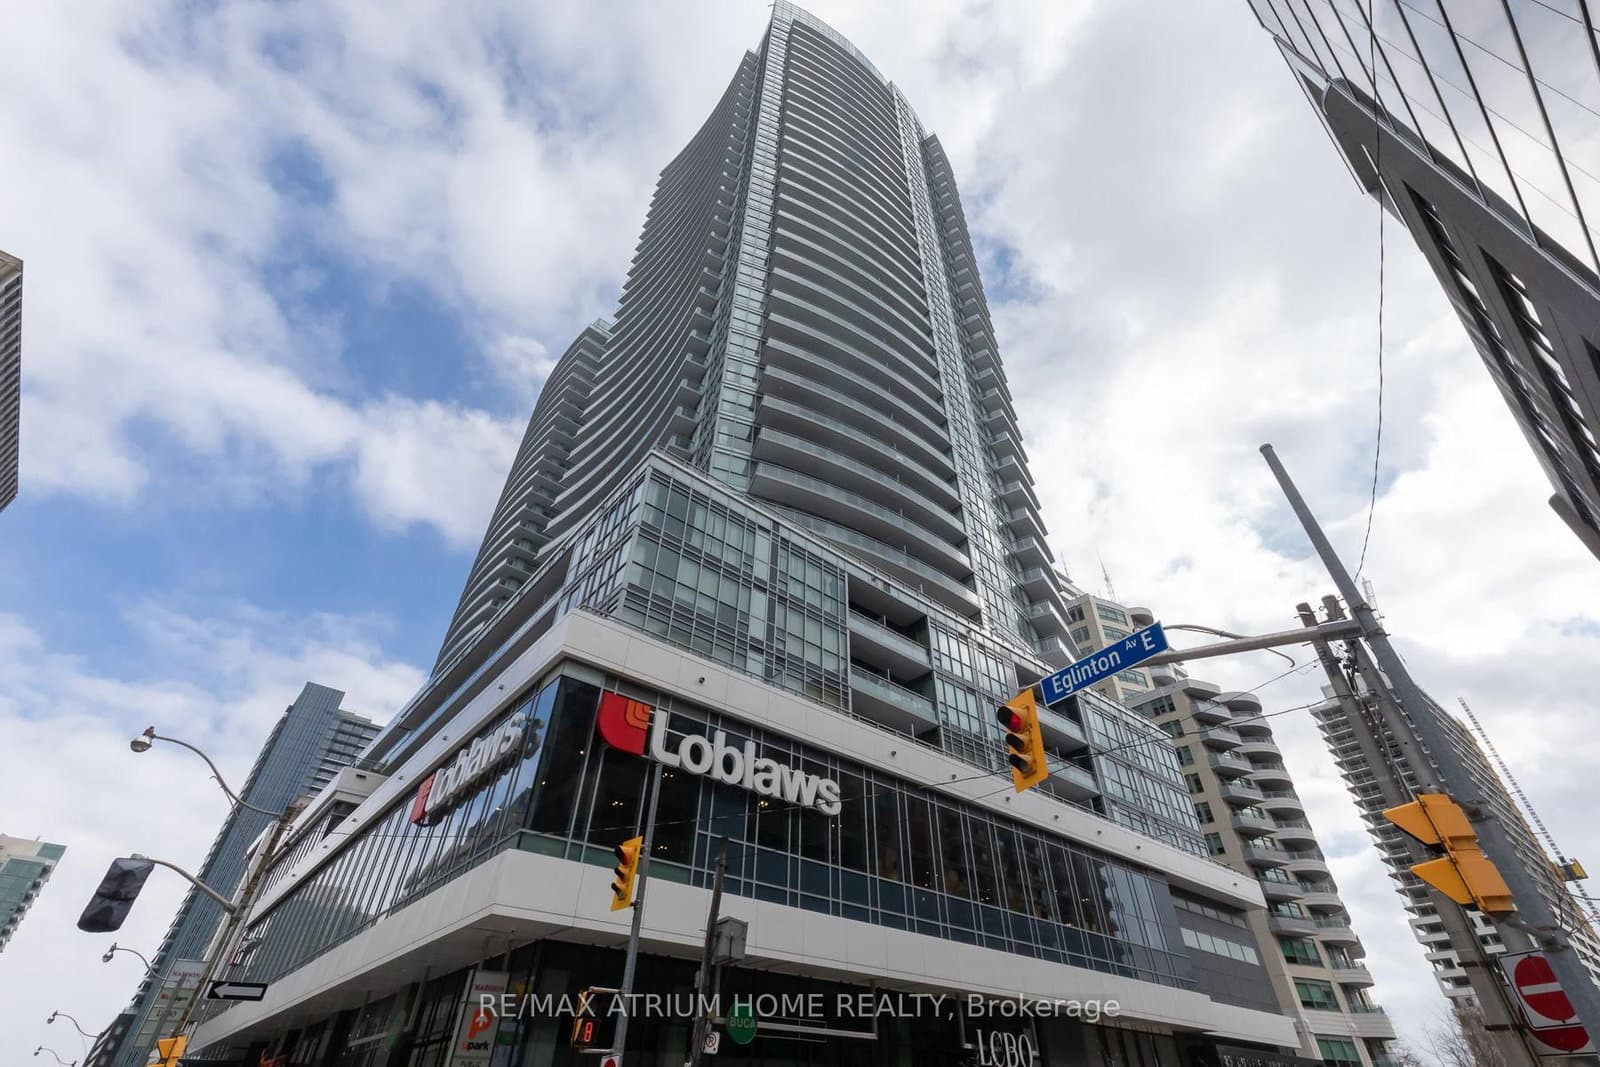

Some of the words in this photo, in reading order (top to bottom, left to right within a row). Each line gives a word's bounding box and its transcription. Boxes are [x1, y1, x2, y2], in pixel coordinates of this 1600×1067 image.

[1052, 651, 1121, 694] Eglinton
[1125, 639, 1137, 651] Av
[1140, 630, 1156, 651] E
[424, 712, 523, 813] Loblaws
[651, 708, 842, 816] Loblaws
[583, 1021, 593, 1043] 8
[729, 1016, 756, 1029] BUCA
[976, 1028, 1034, 1067] LCBO
